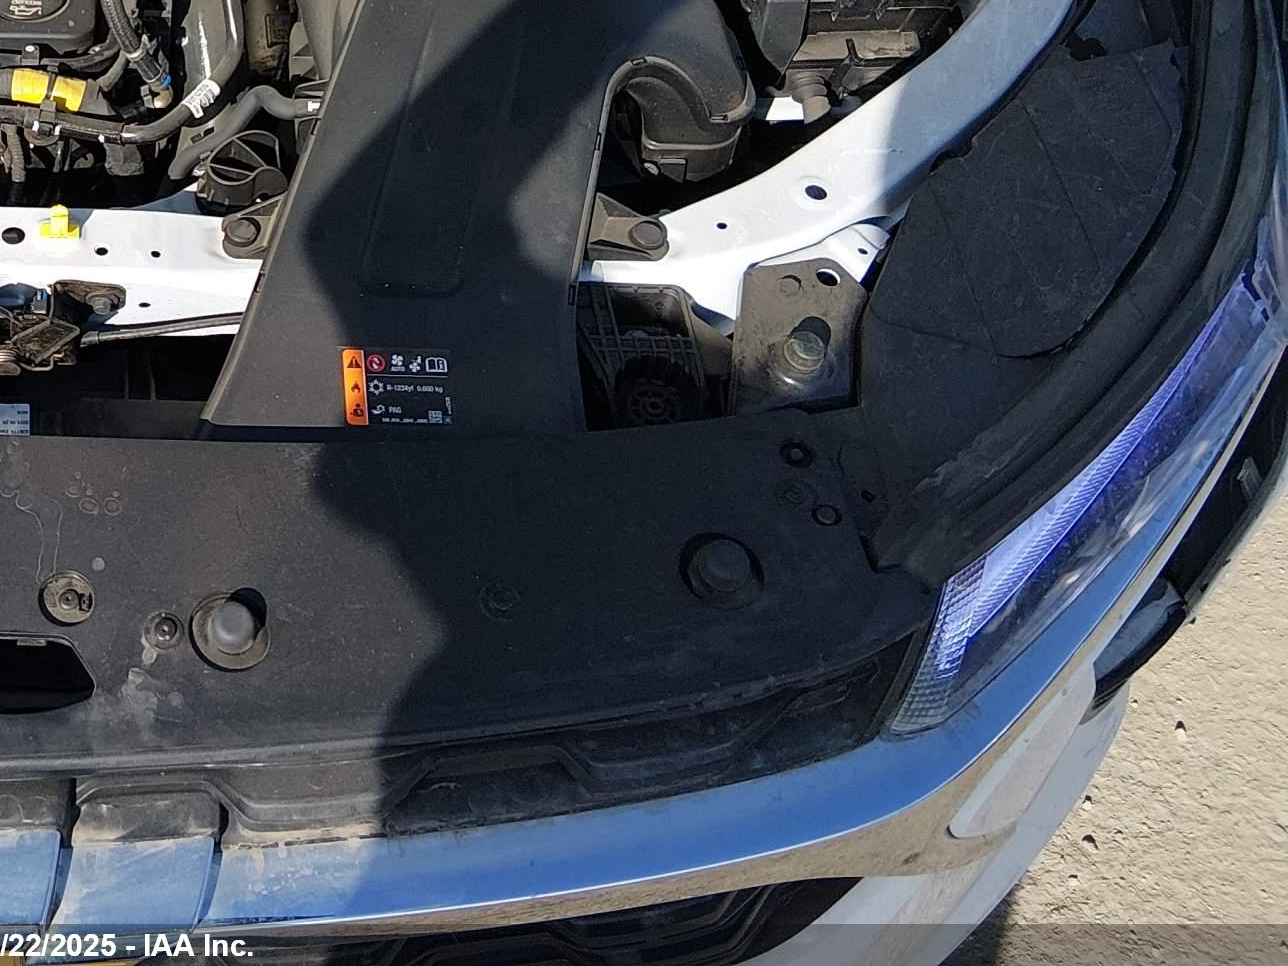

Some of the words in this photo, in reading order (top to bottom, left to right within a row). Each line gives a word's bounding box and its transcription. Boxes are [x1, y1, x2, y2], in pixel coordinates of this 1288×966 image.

[386, 384, 414, 393] R-1234yf
[435, 386, 443, 394] kg
[388, 406, 402, 414] PAG
